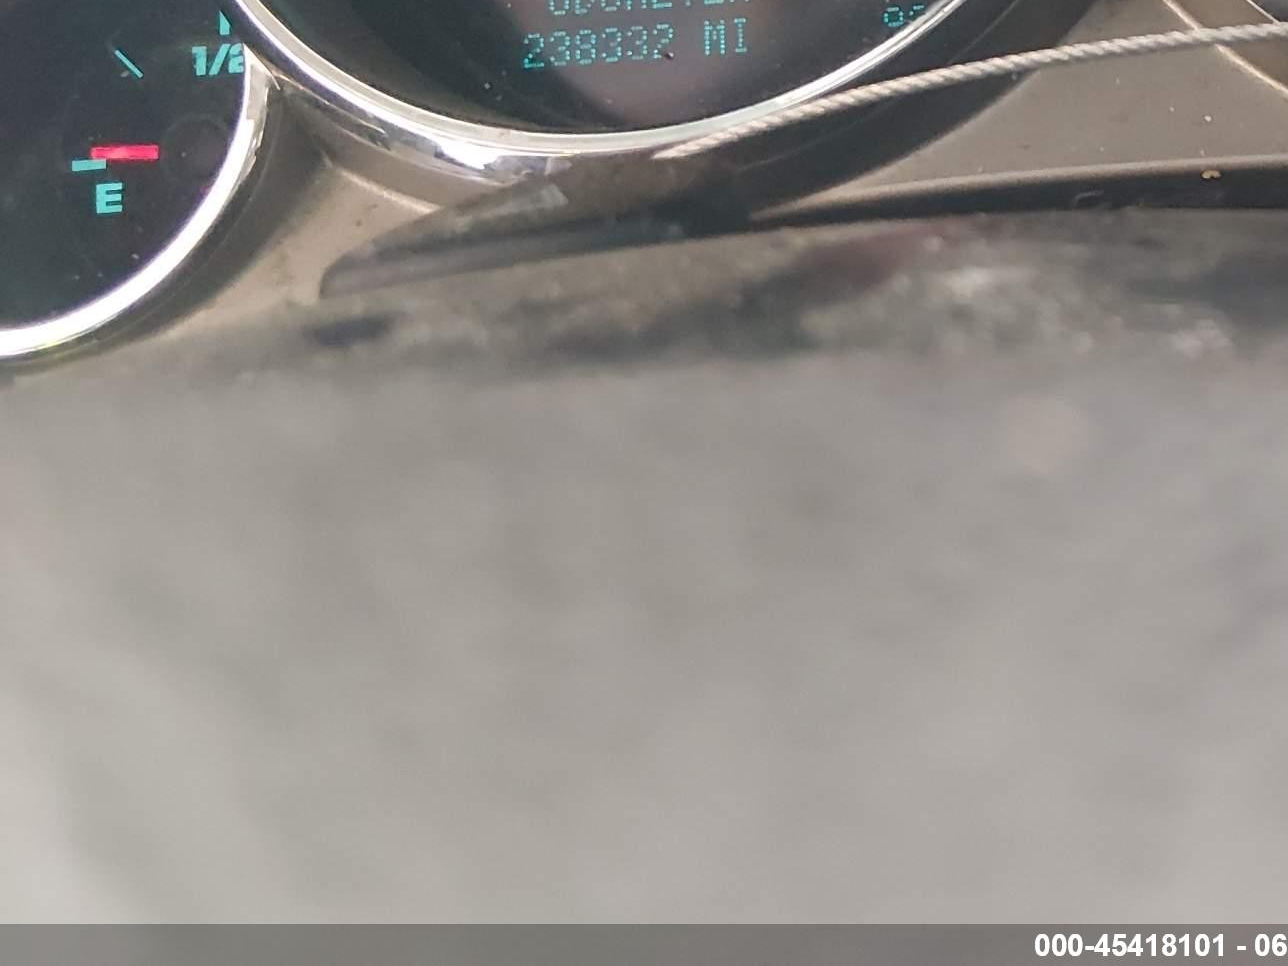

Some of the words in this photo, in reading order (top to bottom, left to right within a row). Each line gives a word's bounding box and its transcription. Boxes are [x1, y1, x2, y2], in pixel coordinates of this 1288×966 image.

[523, 23, 675, 69] 238332
[703, 17, 748, 56] MI
[96, 182, 123, 213] E
